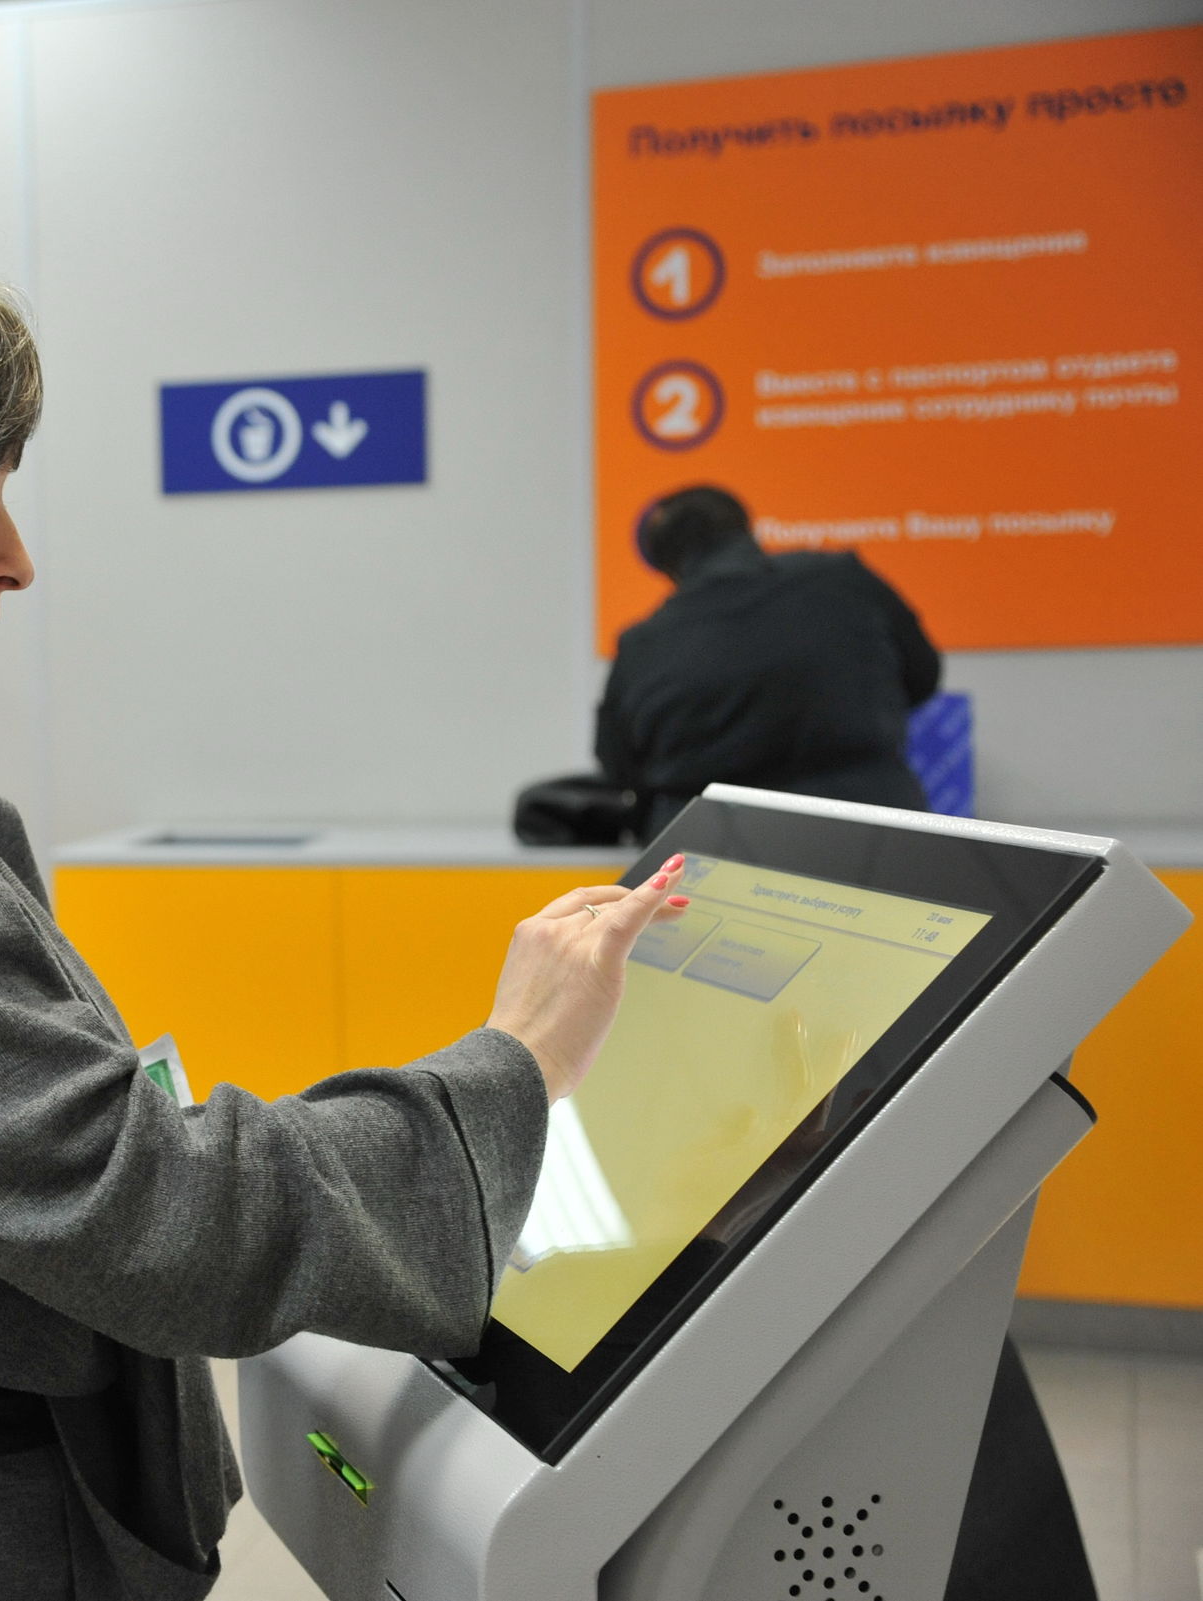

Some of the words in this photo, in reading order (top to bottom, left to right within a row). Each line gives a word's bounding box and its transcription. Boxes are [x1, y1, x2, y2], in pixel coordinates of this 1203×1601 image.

[629, 124, 819, 159] Получить
[830, 98, 1015, 137] посылку
[1025, 77, 1187, 125] просто
[651, 246, 690, 306] 1
[653, 374, 701, 437] 2
